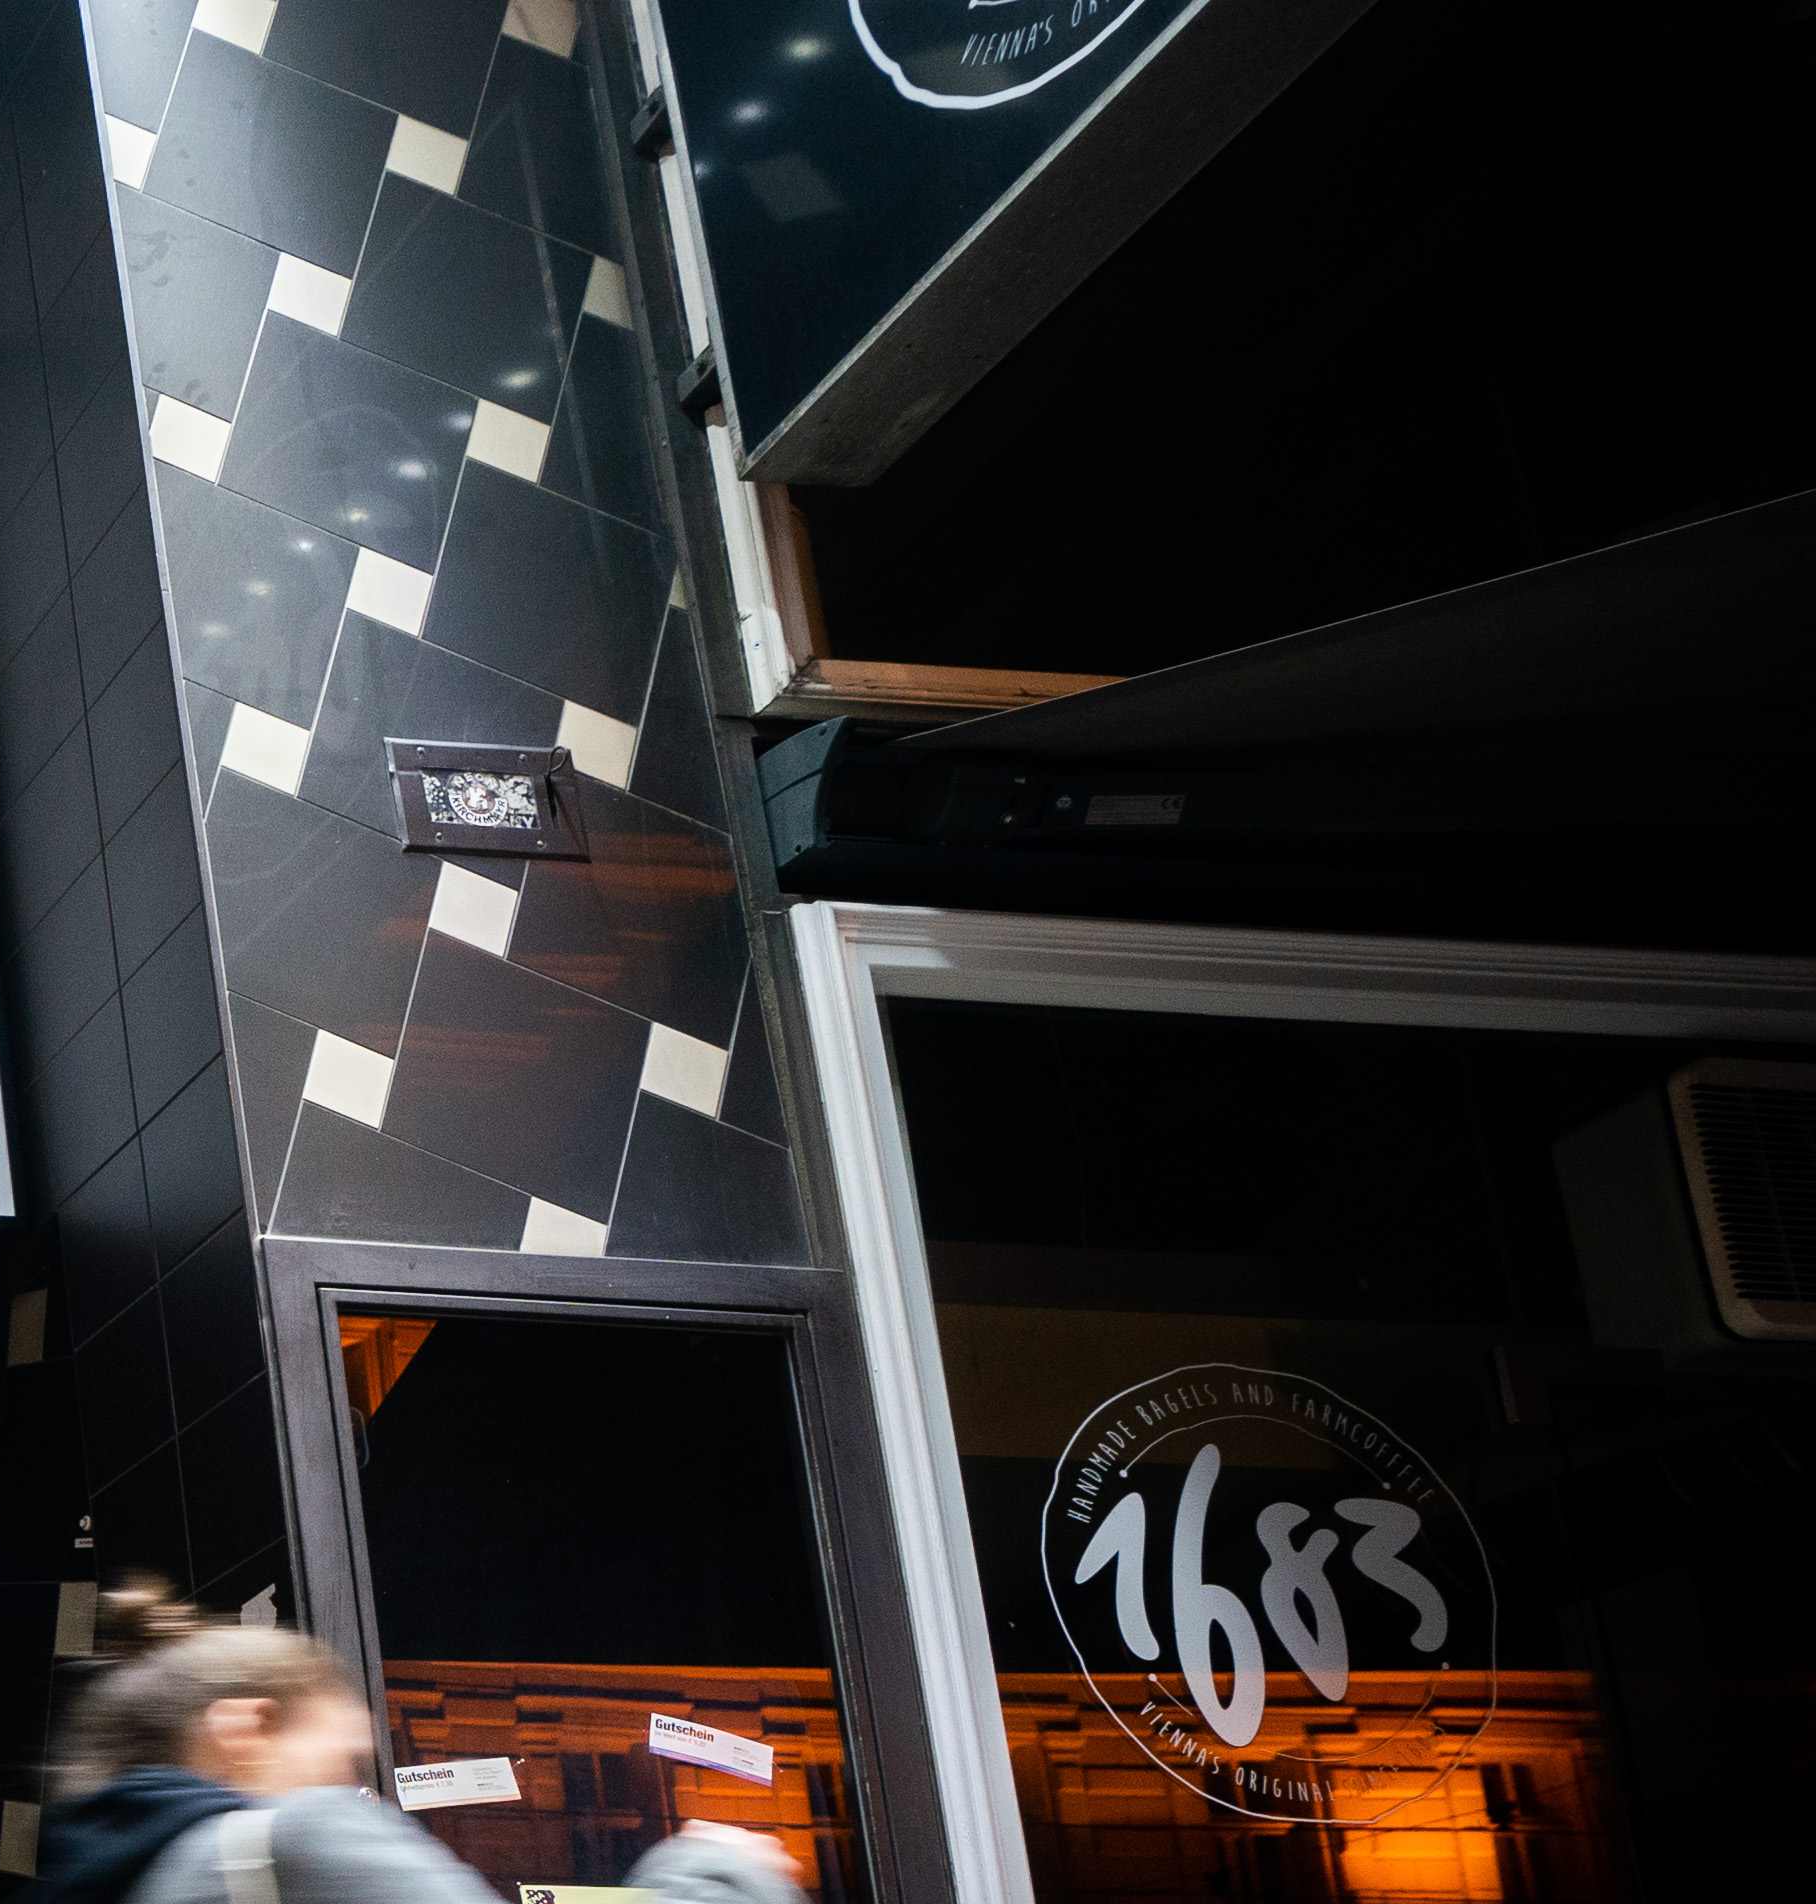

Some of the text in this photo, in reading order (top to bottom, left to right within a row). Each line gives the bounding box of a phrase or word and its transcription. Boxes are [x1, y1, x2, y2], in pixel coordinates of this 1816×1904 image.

[1065, 1381, 1439, 1525] HANDMADE BAGELS AND FARMCOFFEE
[1074, 1442, 1450, 1748] 1683
[397, 1768, 455, 1784] Gutschein
[655, 1718, 714, 1743] Gutschein
[1137, 1700, 1222, 1776] VIENNA'S
[1234, 1766, 1336, 1804] ORIGINAL
